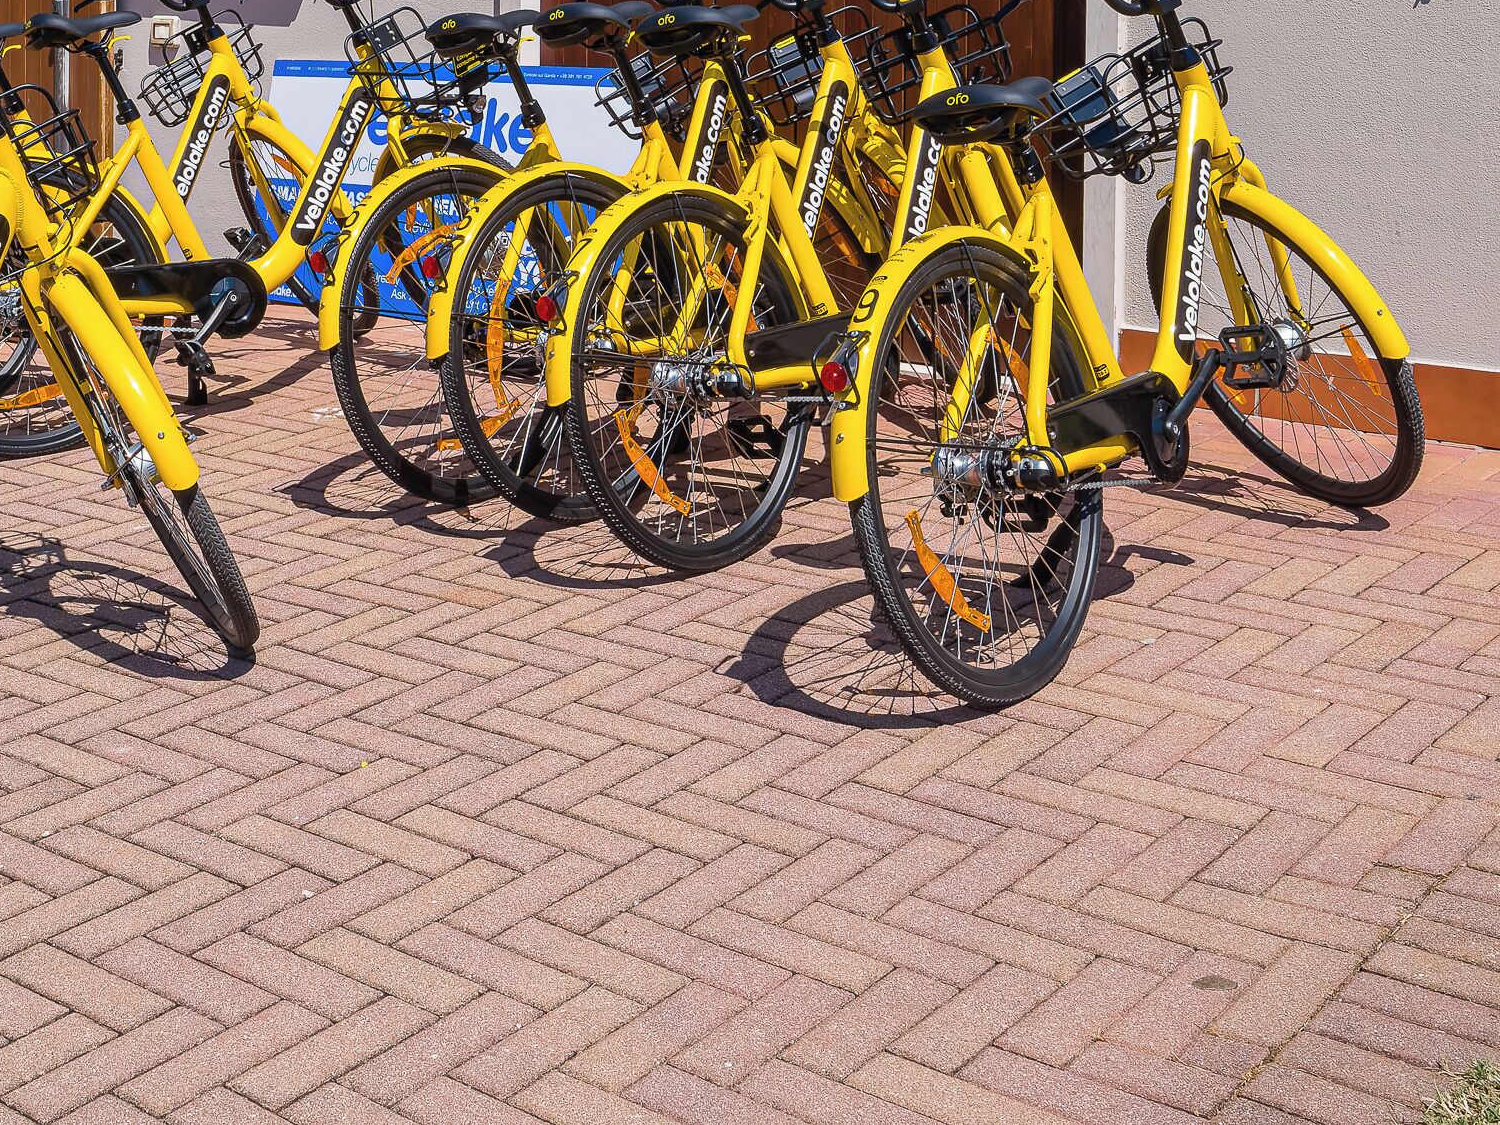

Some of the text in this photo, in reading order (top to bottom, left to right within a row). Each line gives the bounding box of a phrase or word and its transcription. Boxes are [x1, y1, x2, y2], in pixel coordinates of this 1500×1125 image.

[549, 9, 565, 21] ofo
[657, 13, 676, 26] ofo
[441, 19, 456, 30] ofo
[946, 92, 969, 106] ofo
[176, 86, 228, 197] elolake.com
[696, 94, 727, 184] ake.com
[852, 288, 880, 323] 9
